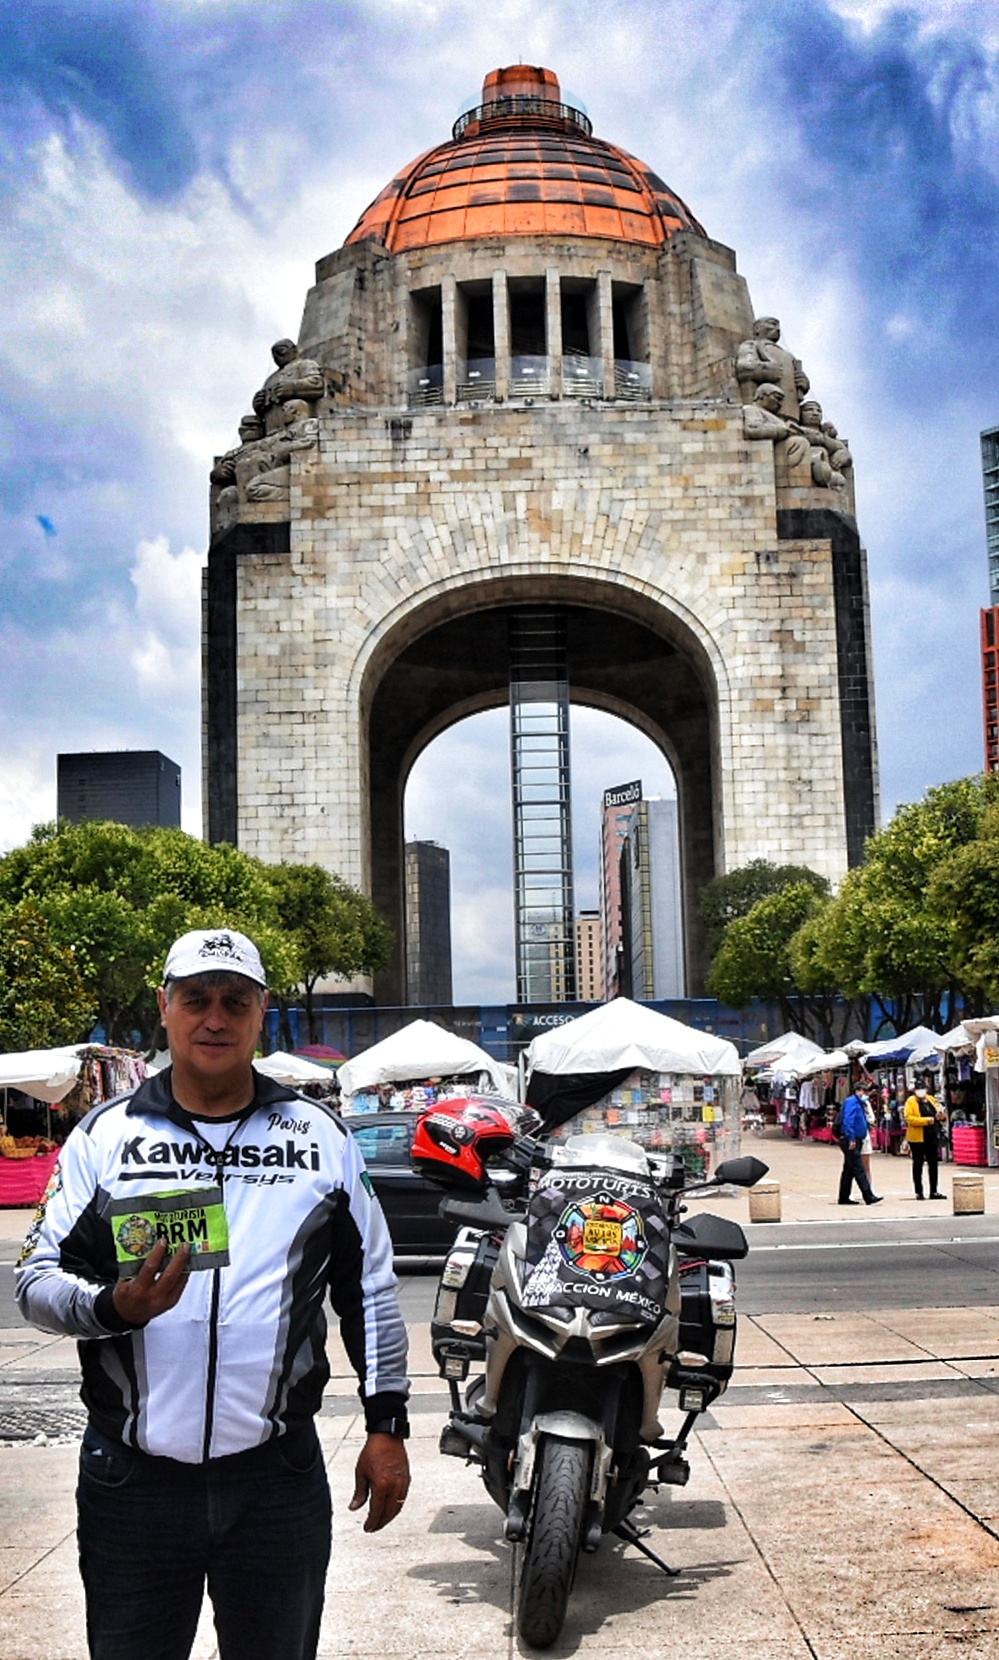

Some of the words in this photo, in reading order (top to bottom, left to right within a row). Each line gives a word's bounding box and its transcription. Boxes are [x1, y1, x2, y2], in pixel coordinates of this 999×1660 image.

[605, 783, 640, 807] Barceló
[121, 1136, 320, 1171] Kawasaki
[615, 1290, 661, 1315] MÉXICO
